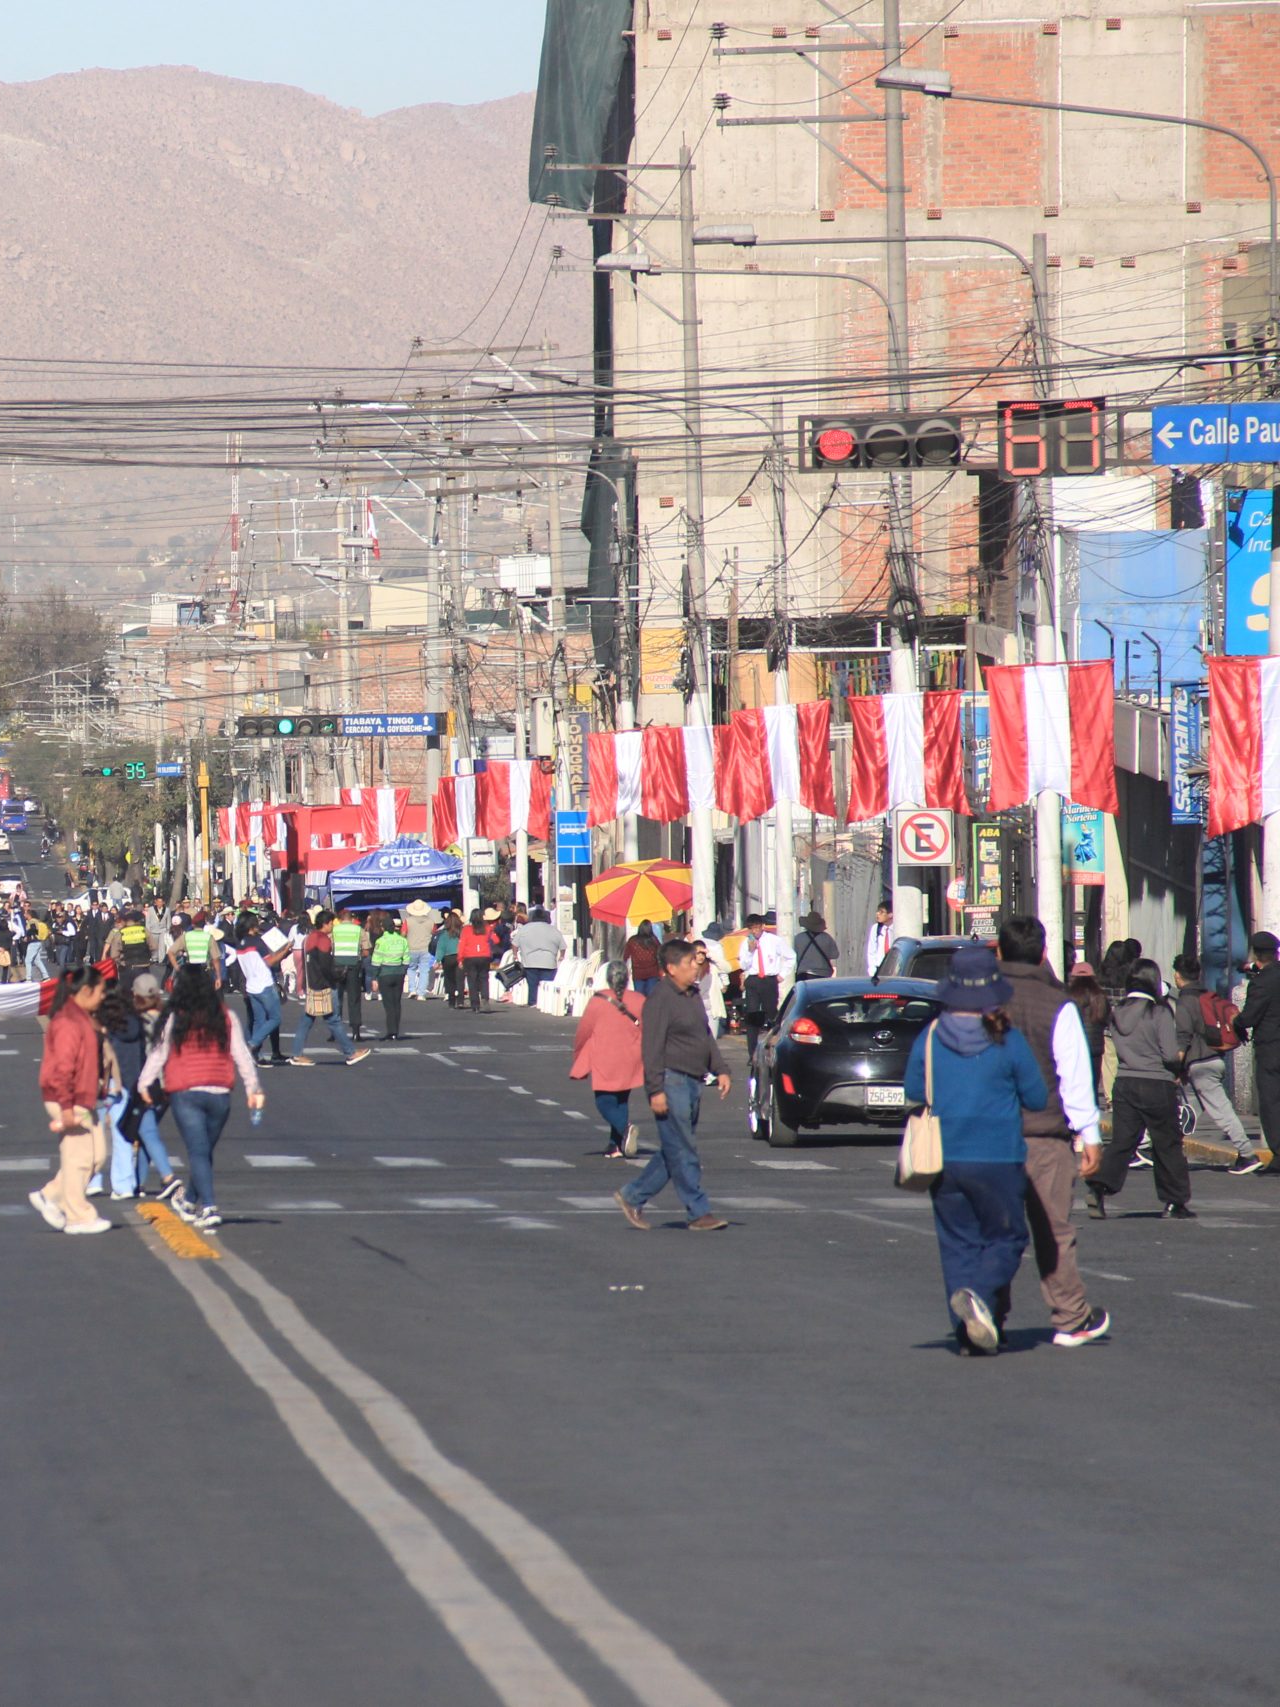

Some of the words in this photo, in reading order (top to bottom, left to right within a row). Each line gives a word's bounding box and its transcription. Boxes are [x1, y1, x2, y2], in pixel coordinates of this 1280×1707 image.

[1004, 401, 1100, 476] 67
[1189, 417, 1240, 445] Calle
[344, 717, 382, 725] TIABAYA
[386, 716, 414, 724] TINGO
[387, 725, 423, 733] GOYENECHE
[125, 762, 146, 780] 35
[390, 852, 430, 868] CITEC
